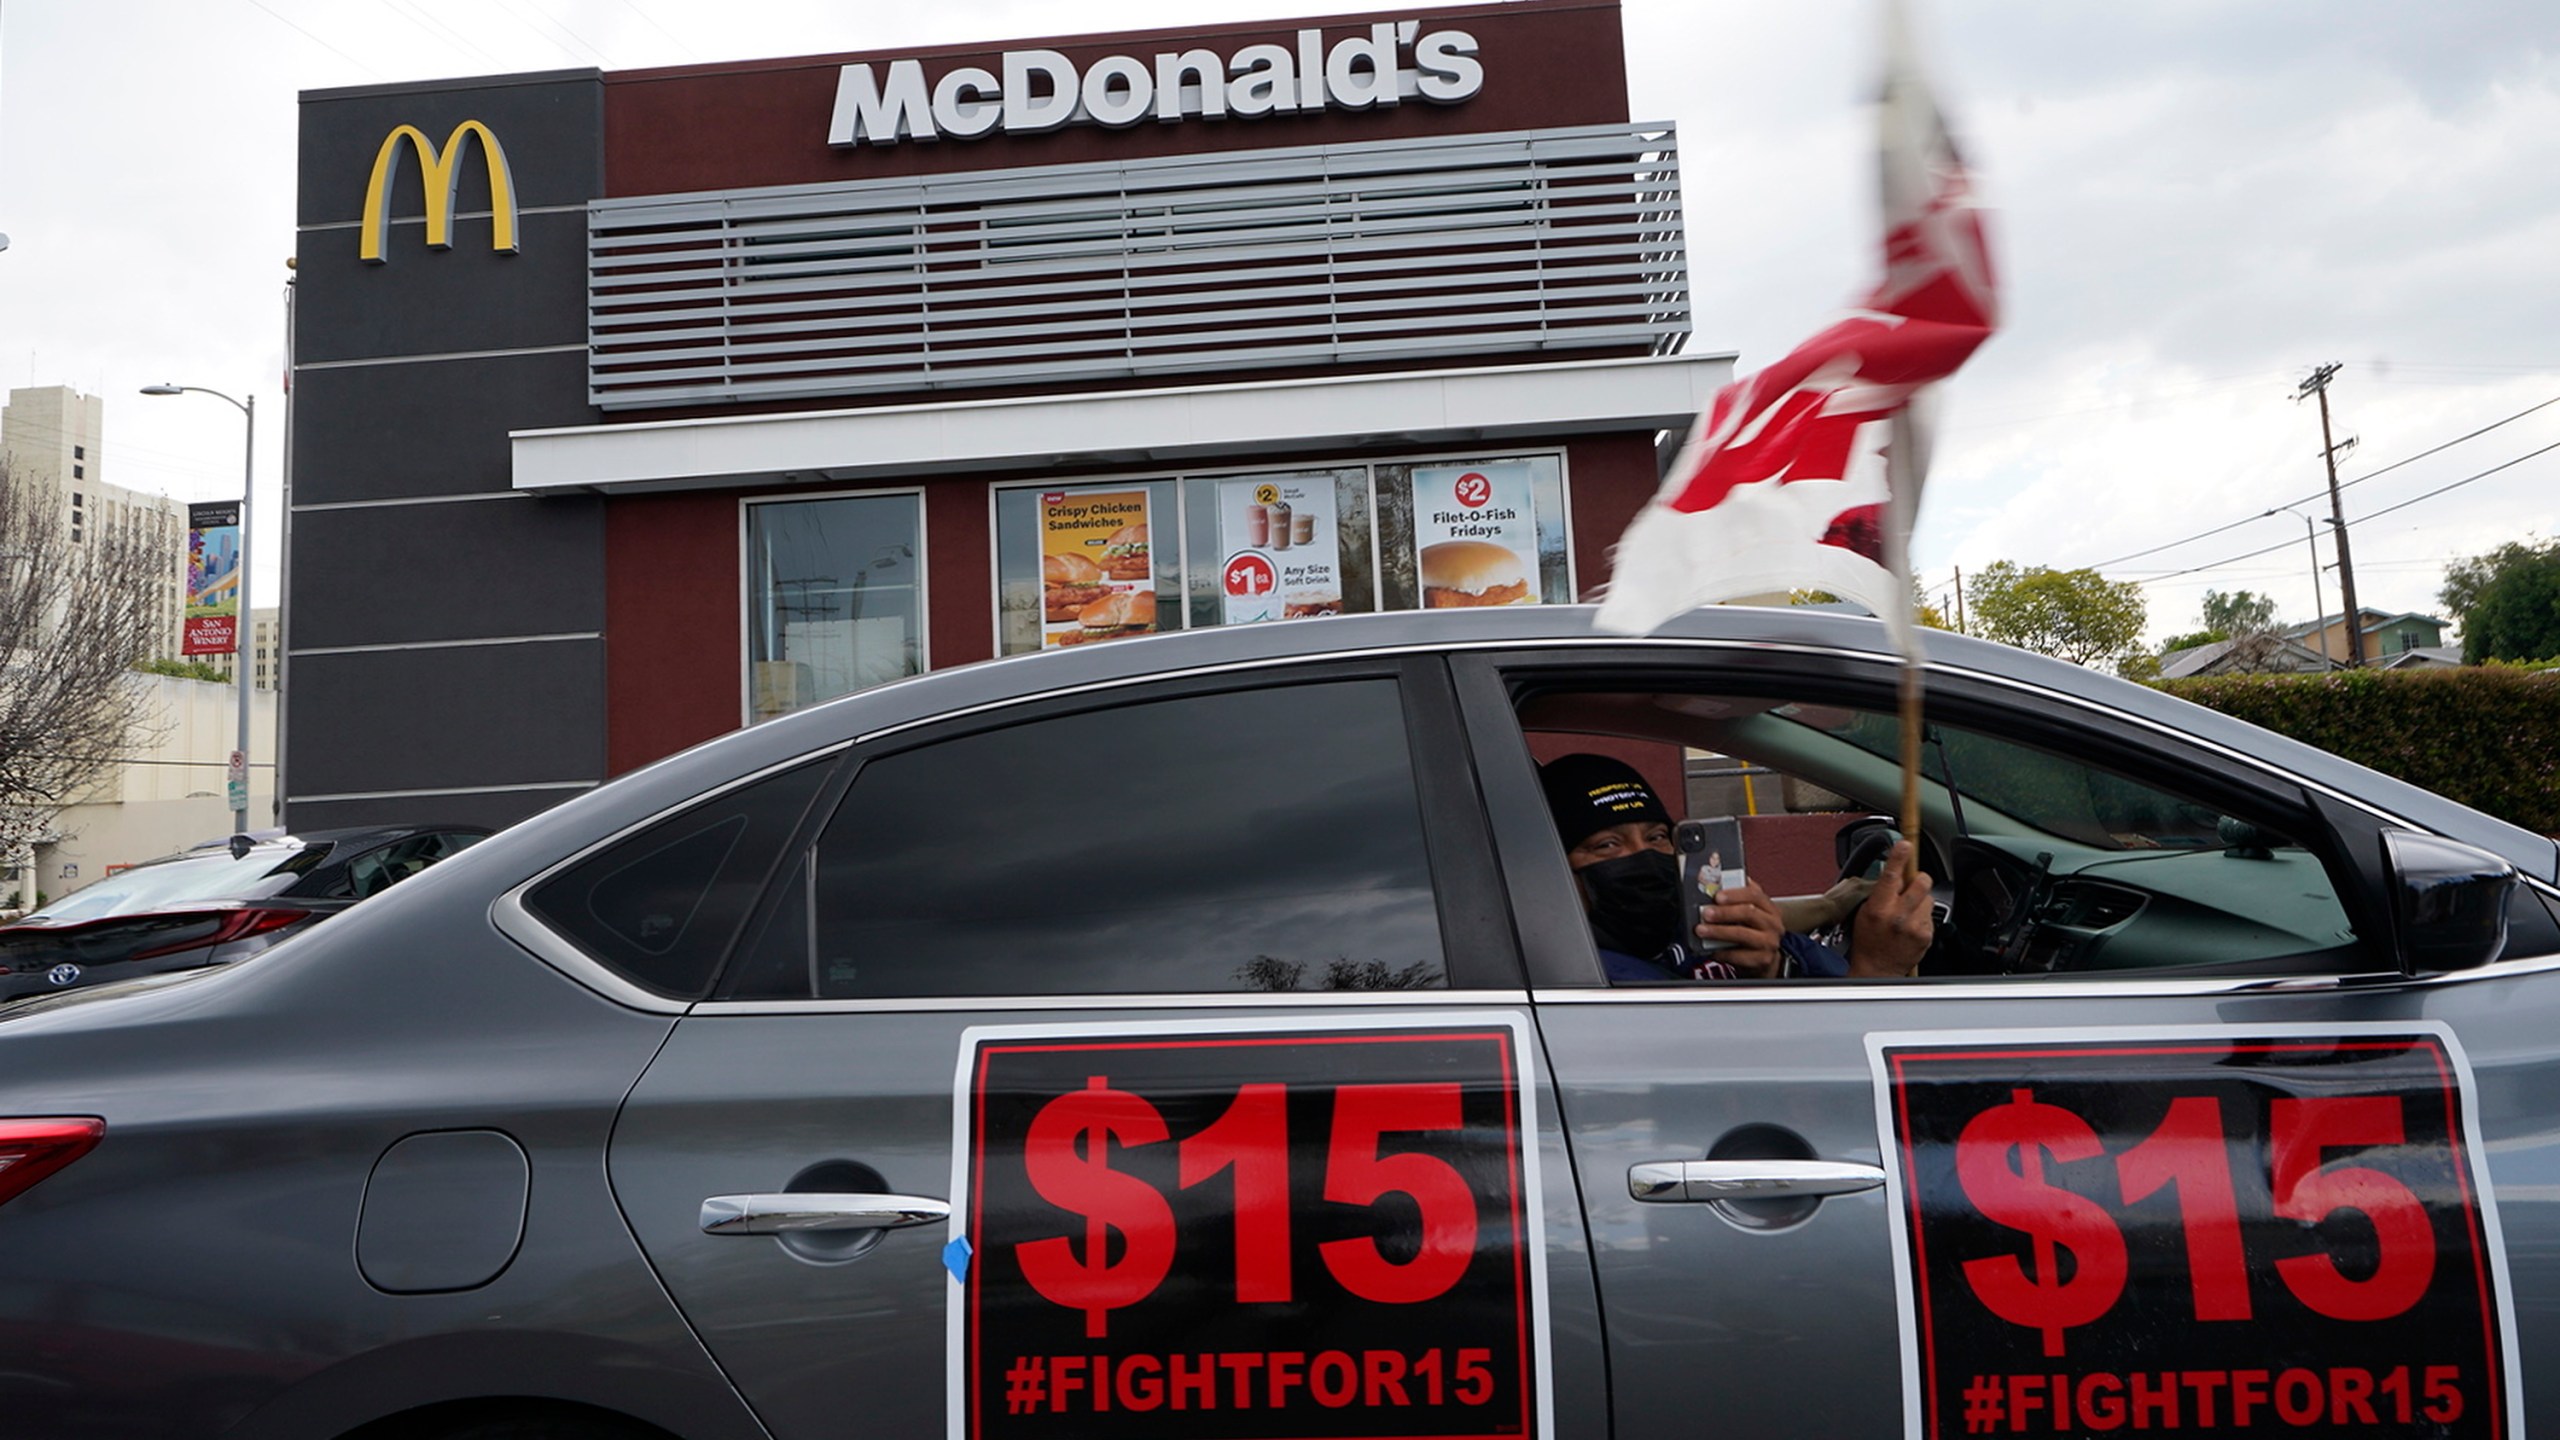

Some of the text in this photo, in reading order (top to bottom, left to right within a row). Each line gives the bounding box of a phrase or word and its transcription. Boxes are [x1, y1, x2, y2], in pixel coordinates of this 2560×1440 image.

[827, 20, 1485, 148] McDonald's
[1458, 479, 1486, 501] $2
[1048, 503, 1142, 518] Crispy Chicken
[1433, 508, 1516, 524] Filet-O-Fish
[1049, 518, 1124, 531] Sandwiches
[1450, 524, 1502, 538] Fridays
[1284, 564, 1331, 577] Any Size
[1284, 576, 1330, 586] Soft Drink
[202, 619, 221, 628] SAN
[189, 627, 232, 638] ANTONIO
[192, 636, 228, 645] WINERY
[1015, 1076, 1478, 1338] $15
[1955, 1088, 2437, 1358] $15
[1005, 1347, 1495, 1415] #FIGHTFOR15
[1963, 1365, 2465, 1434] #FIGHTFOR15
